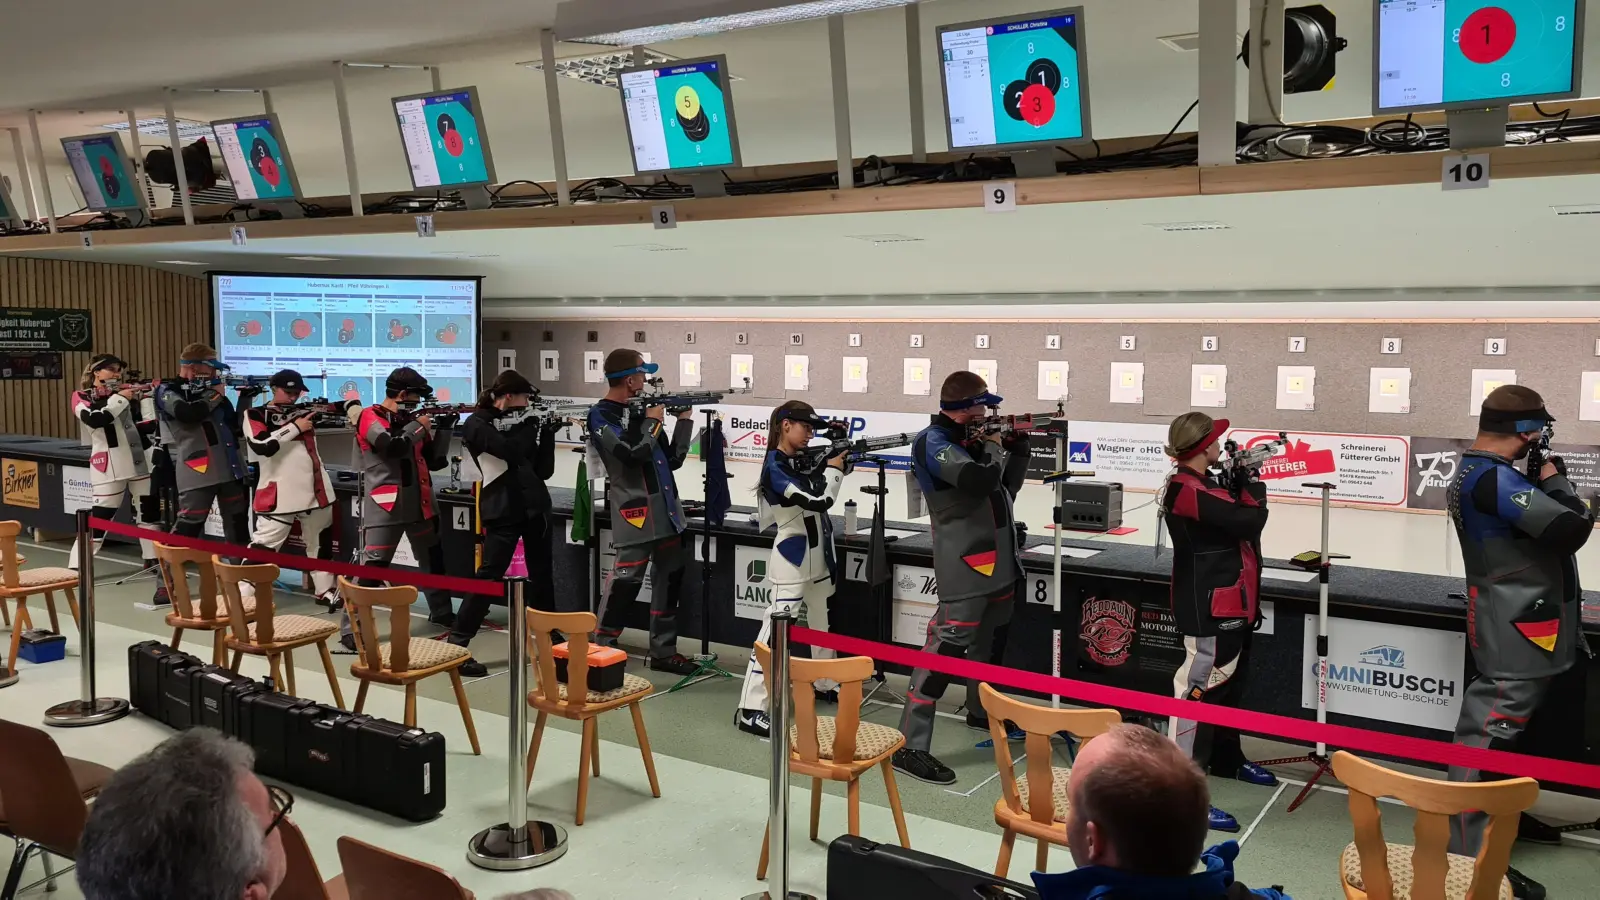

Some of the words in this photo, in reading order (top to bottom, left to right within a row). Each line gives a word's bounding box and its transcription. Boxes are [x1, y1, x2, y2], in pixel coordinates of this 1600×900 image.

[1555, 16, 1565, 31] 8
[1452, 28, 1460, 43] 8
[1481, 24, 1490, 45] 1
[1028, 42, 1034, 53] 8
[1038, 71, 1046, 86] 1
[1063, 77, 1070, 88] 8
[1501, 73, 1510, 87] 8
[684, 96, 691, 108] 5
[1015, 92, 1025, 108] 2
[1033, 97, 1041, 112] 3
[443, 121, 448, 132] 7
[258, 146, 265, 157] 3
[1449, 162, 1483, 182] 10
[994, 188, 1005, 204] 9
[660, 211, 668, 224] 8
[14, 330, 31, 338] 1921
[687, 334, 691, 342] 8
[739, 334, 743, 342] 9
[792, 335, 800, 343] 10
[853, 337, 856, 345] 1
[980, 338, 985, 347] 3
[1050, 338, 1056, 347] 4
[1125, 339, 1130, 348] 5
[1207, 339, 1213, 349] 6
[1294, 341, 1300, 350] 7
[1388, 342, 1395, 352] 8
[1492, 342, 1499, 353] 9
[1097, 444, 1135, 453] Wagner
[1341, 444, 1386, 452] Schreinerei
[1069, 452, 1088, 462] AXA
[1340, 453, 1372, 461] Fütterer
[1415, 451, 1457, 496] 75
[5, 473, 36, 494] Birkner
[626, 509, 644, 518] GER
[458, 511, 465, 528] 4
[854, 558, 864, 578] 7
[1035, 579, 1047, 602] 8
[1316, 680, 1448, 706] WW.VERMIETUNG-BUSCH.DE
